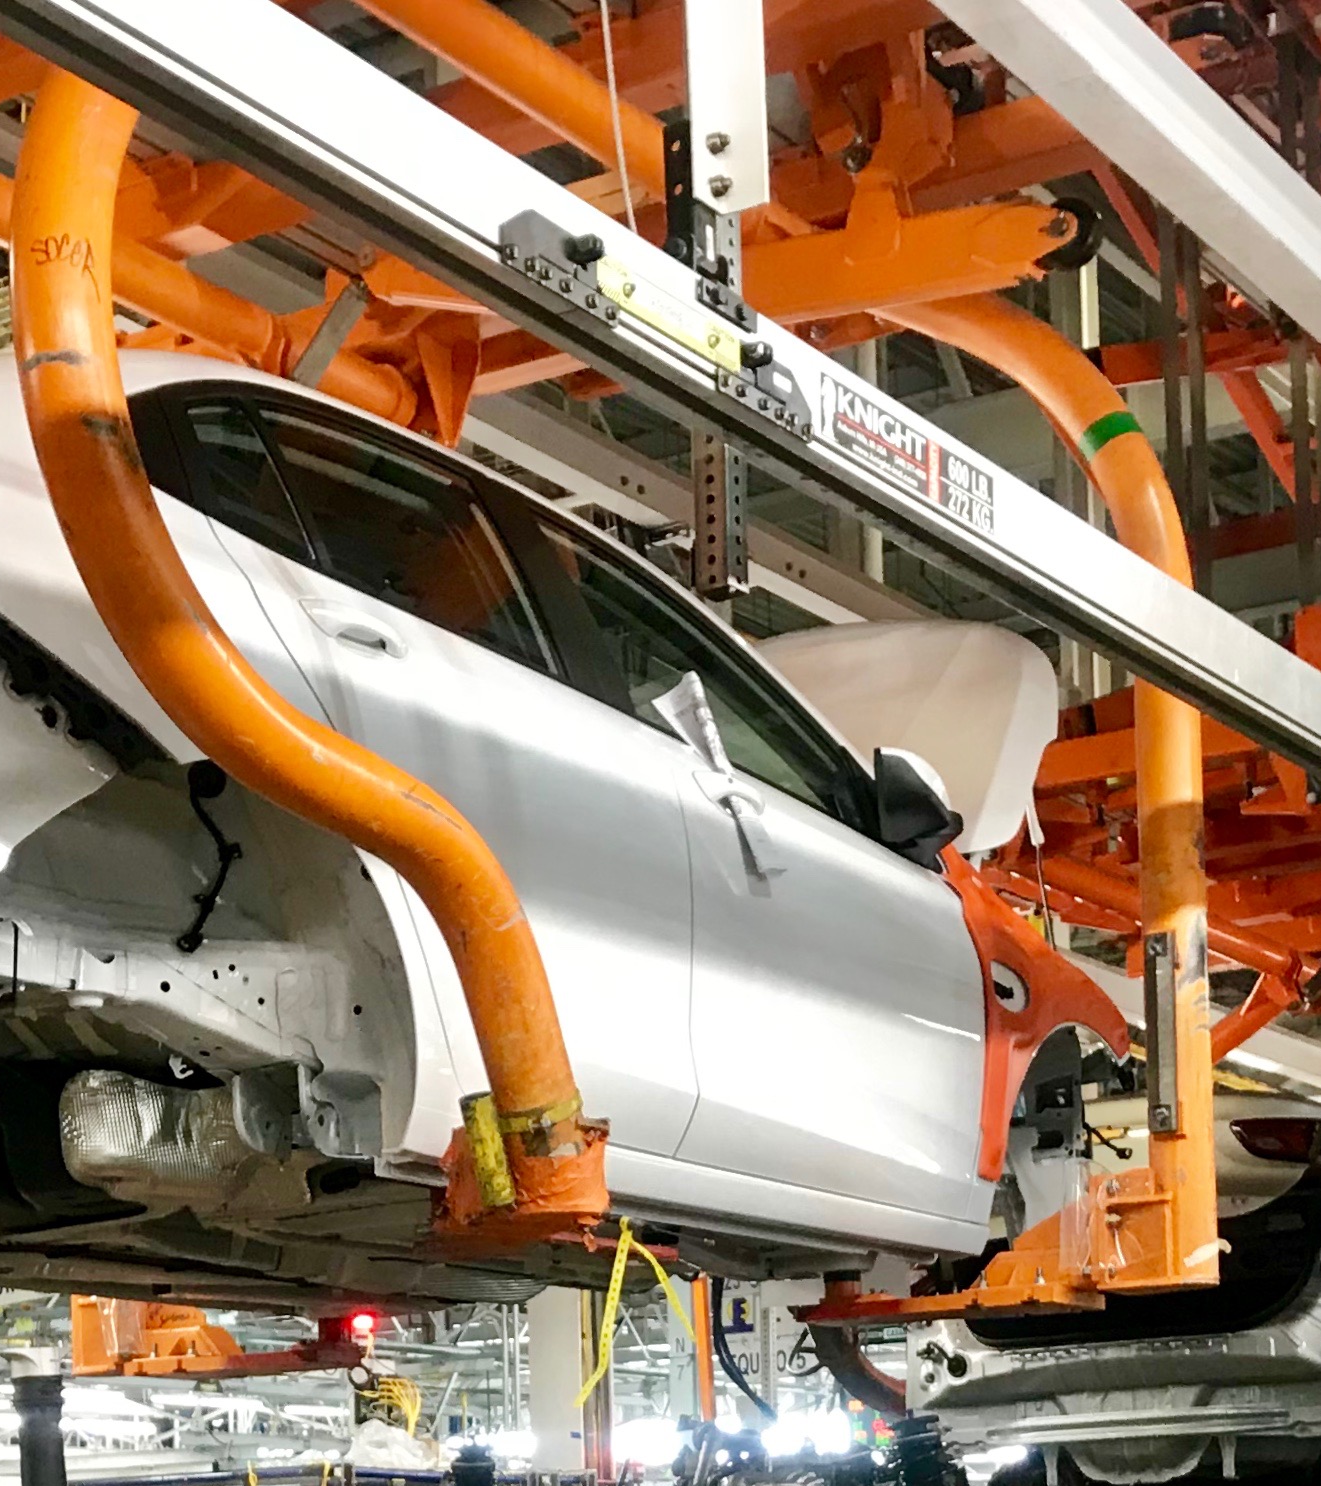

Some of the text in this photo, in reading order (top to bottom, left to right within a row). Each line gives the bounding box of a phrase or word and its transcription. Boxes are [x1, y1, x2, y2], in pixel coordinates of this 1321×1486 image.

[837, 384, 927, 462] KNIGHT
[947, 455, 969, 490] 600
[947, 486, 970, 521] 272
[675, 1337, 685, 1353] N
